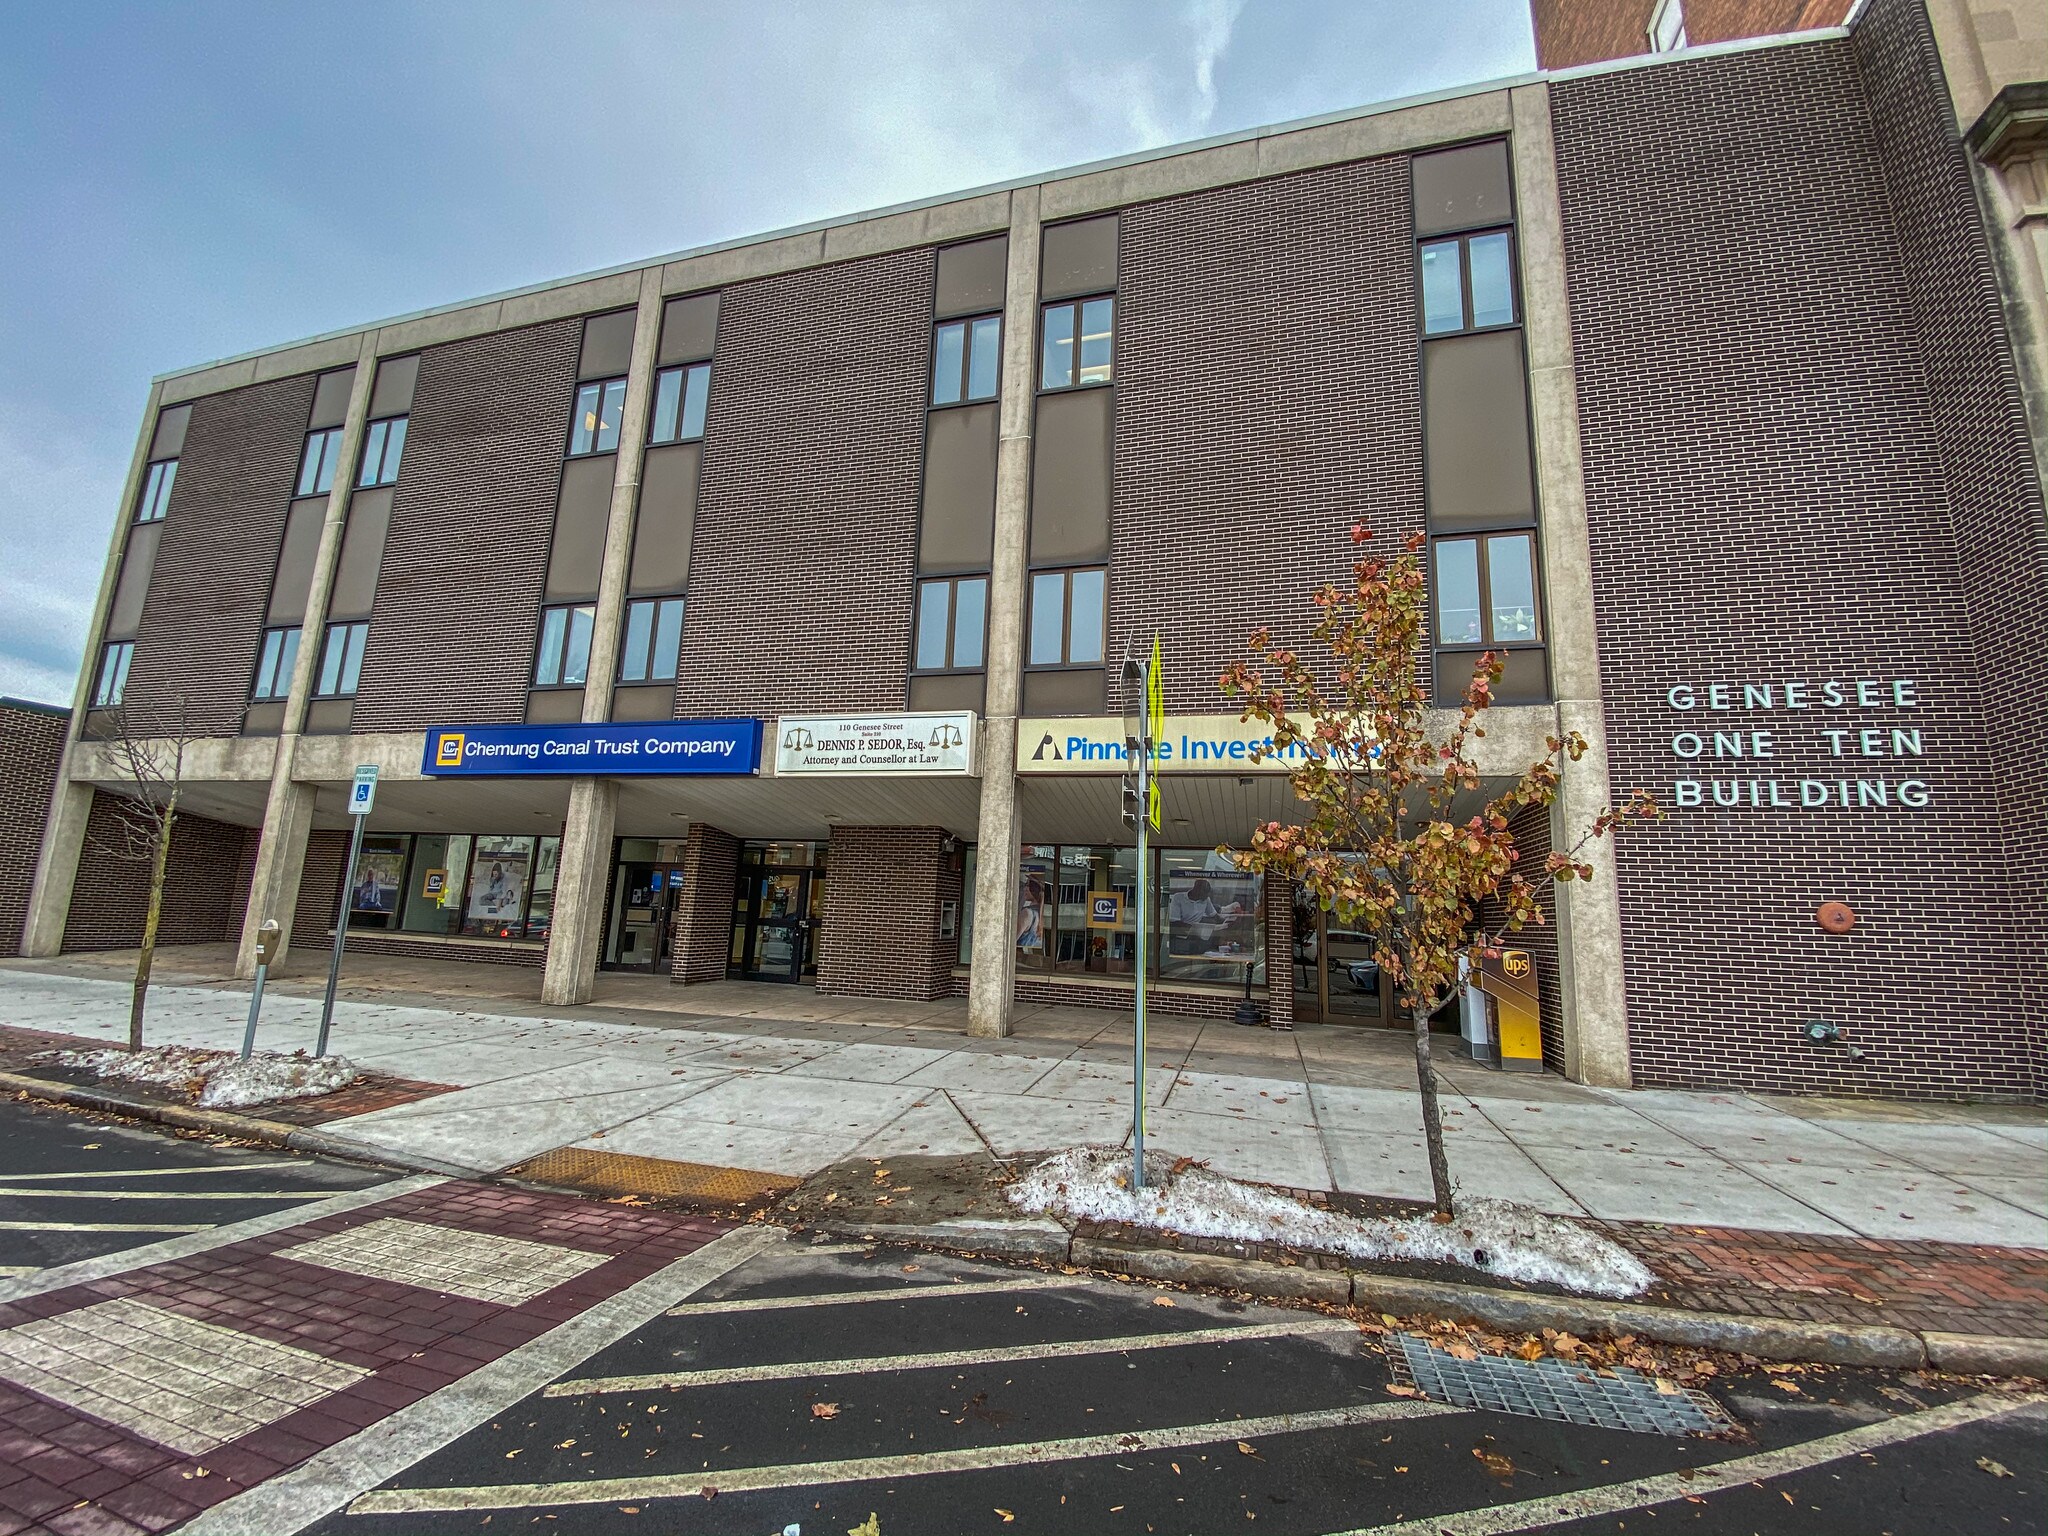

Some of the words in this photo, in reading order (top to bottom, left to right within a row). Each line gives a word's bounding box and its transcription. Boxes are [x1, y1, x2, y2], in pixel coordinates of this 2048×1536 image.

[1666, 679, 1917, 711] GENESEE
[852, 723, 881, 731] Genesee
[882, 723, 903, 731] Street
[465, 741, 539, 759] Chemung
[543, 739, 590, 755] Canal
[594, 739, 639, 755] Trust
[644, 738, 736, 757] Company
[817, 739, 856, 751] DENNIS
[857, 739, 865, 751] P.
[867, 738, 906, 752] SEDOR,
[906, 738, 926, 752] Esq.
[1066, 736, 1173, 760] Pinne
[1671, 731, 1774, 758] ONE
[1820, 728, 1923, 757] TEN
[803, 755, 840, 766] Attorney
[841, 754, 857, 764] and
[859, 754, 907, 764] Counsellor
[908, 755, 917, 763] at
[919, 753, 939, 763] Law
[1674, 779, 1930, 808] BUILDING
[1506, 959, 1528, 975] ups
